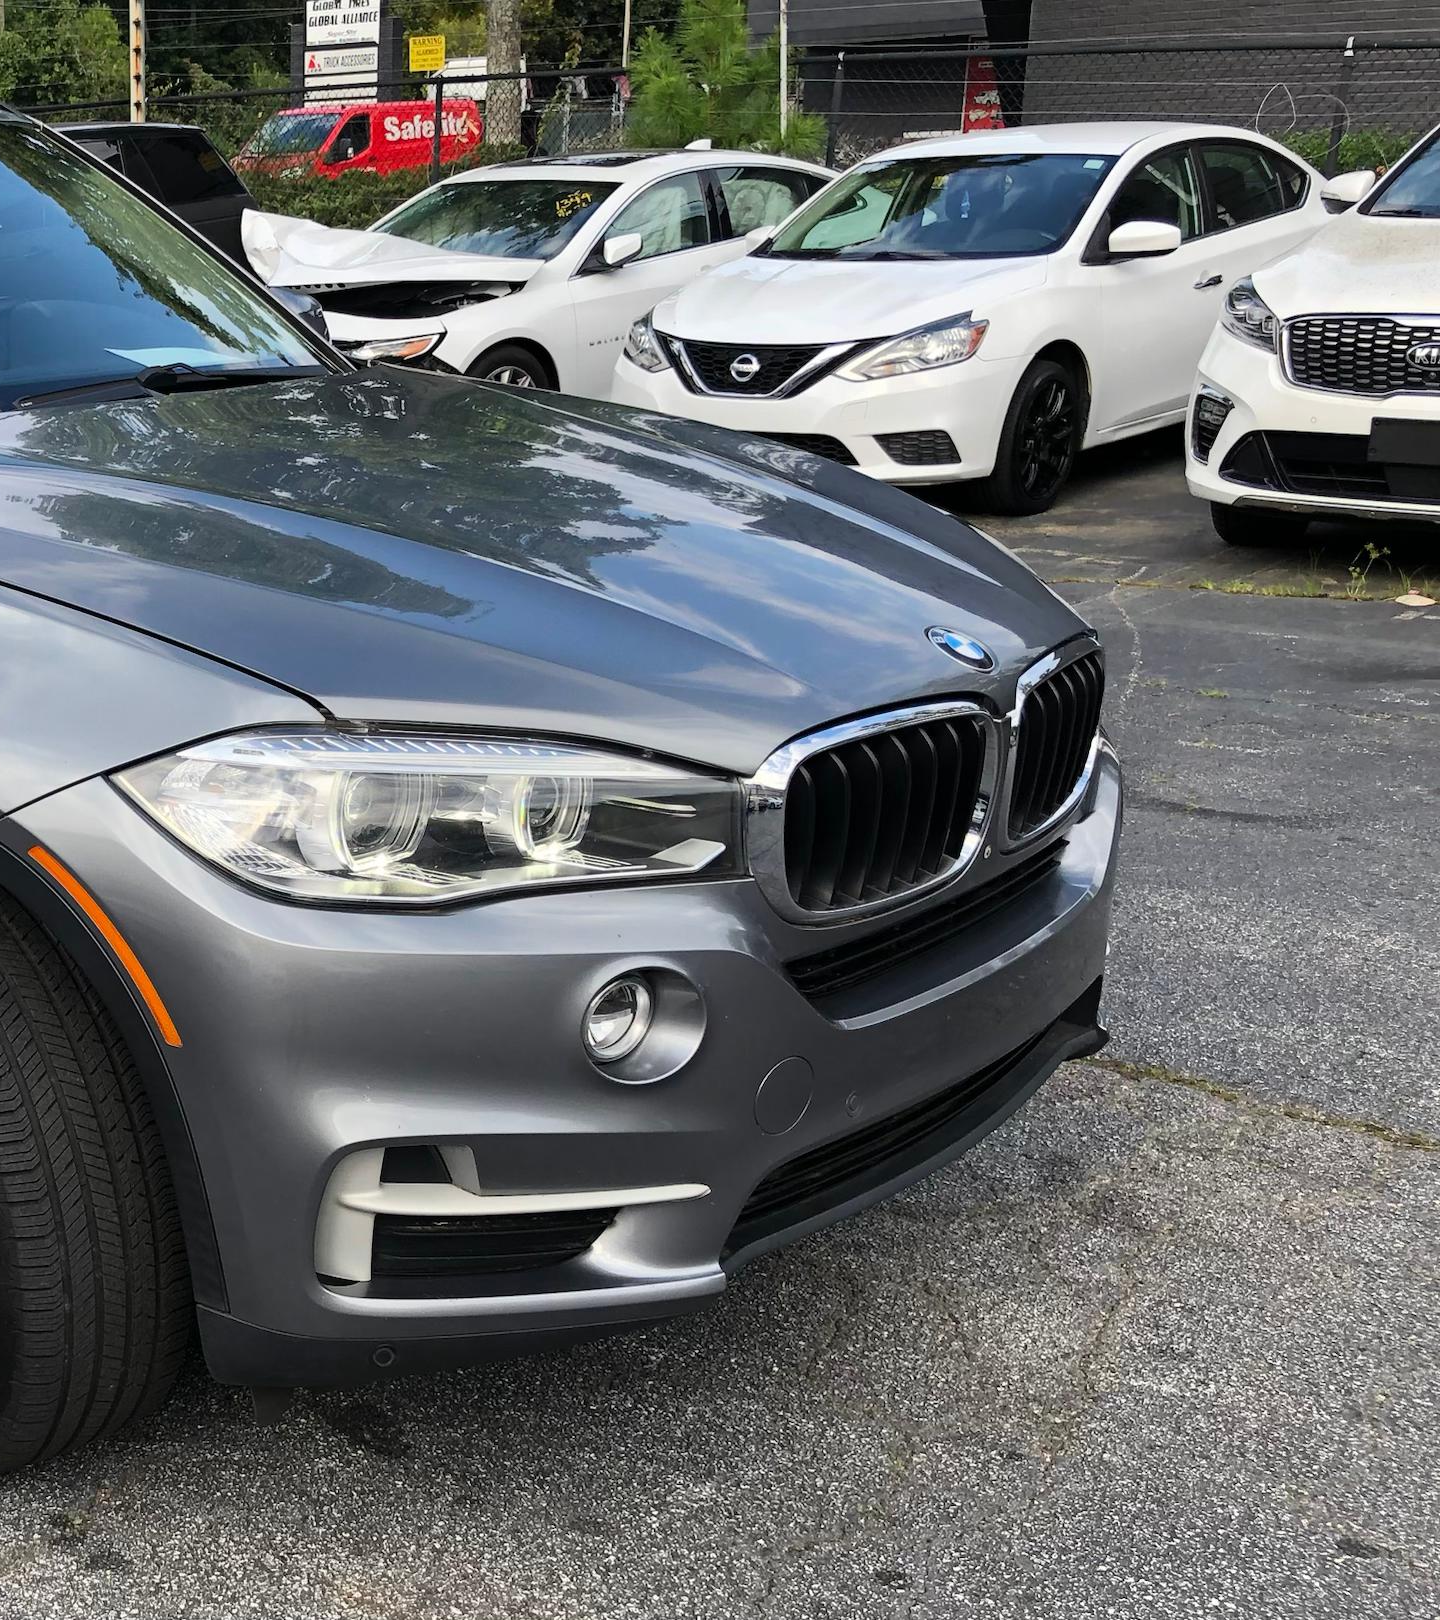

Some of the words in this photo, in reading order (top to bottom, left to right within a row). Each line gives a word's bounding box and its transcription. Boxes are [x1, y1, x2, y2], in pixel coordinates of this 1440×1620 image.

[309, 14, 338, 27] GLOBAL
[341, 11, 378, 24] ALLIANCE
[323, 56, 340, 68] TRUCK
[341, 53, 375, 66] ACCESSORIES
[384, 111, 468, 141] Safeite
[1415, 347, 1440, 364] KI
